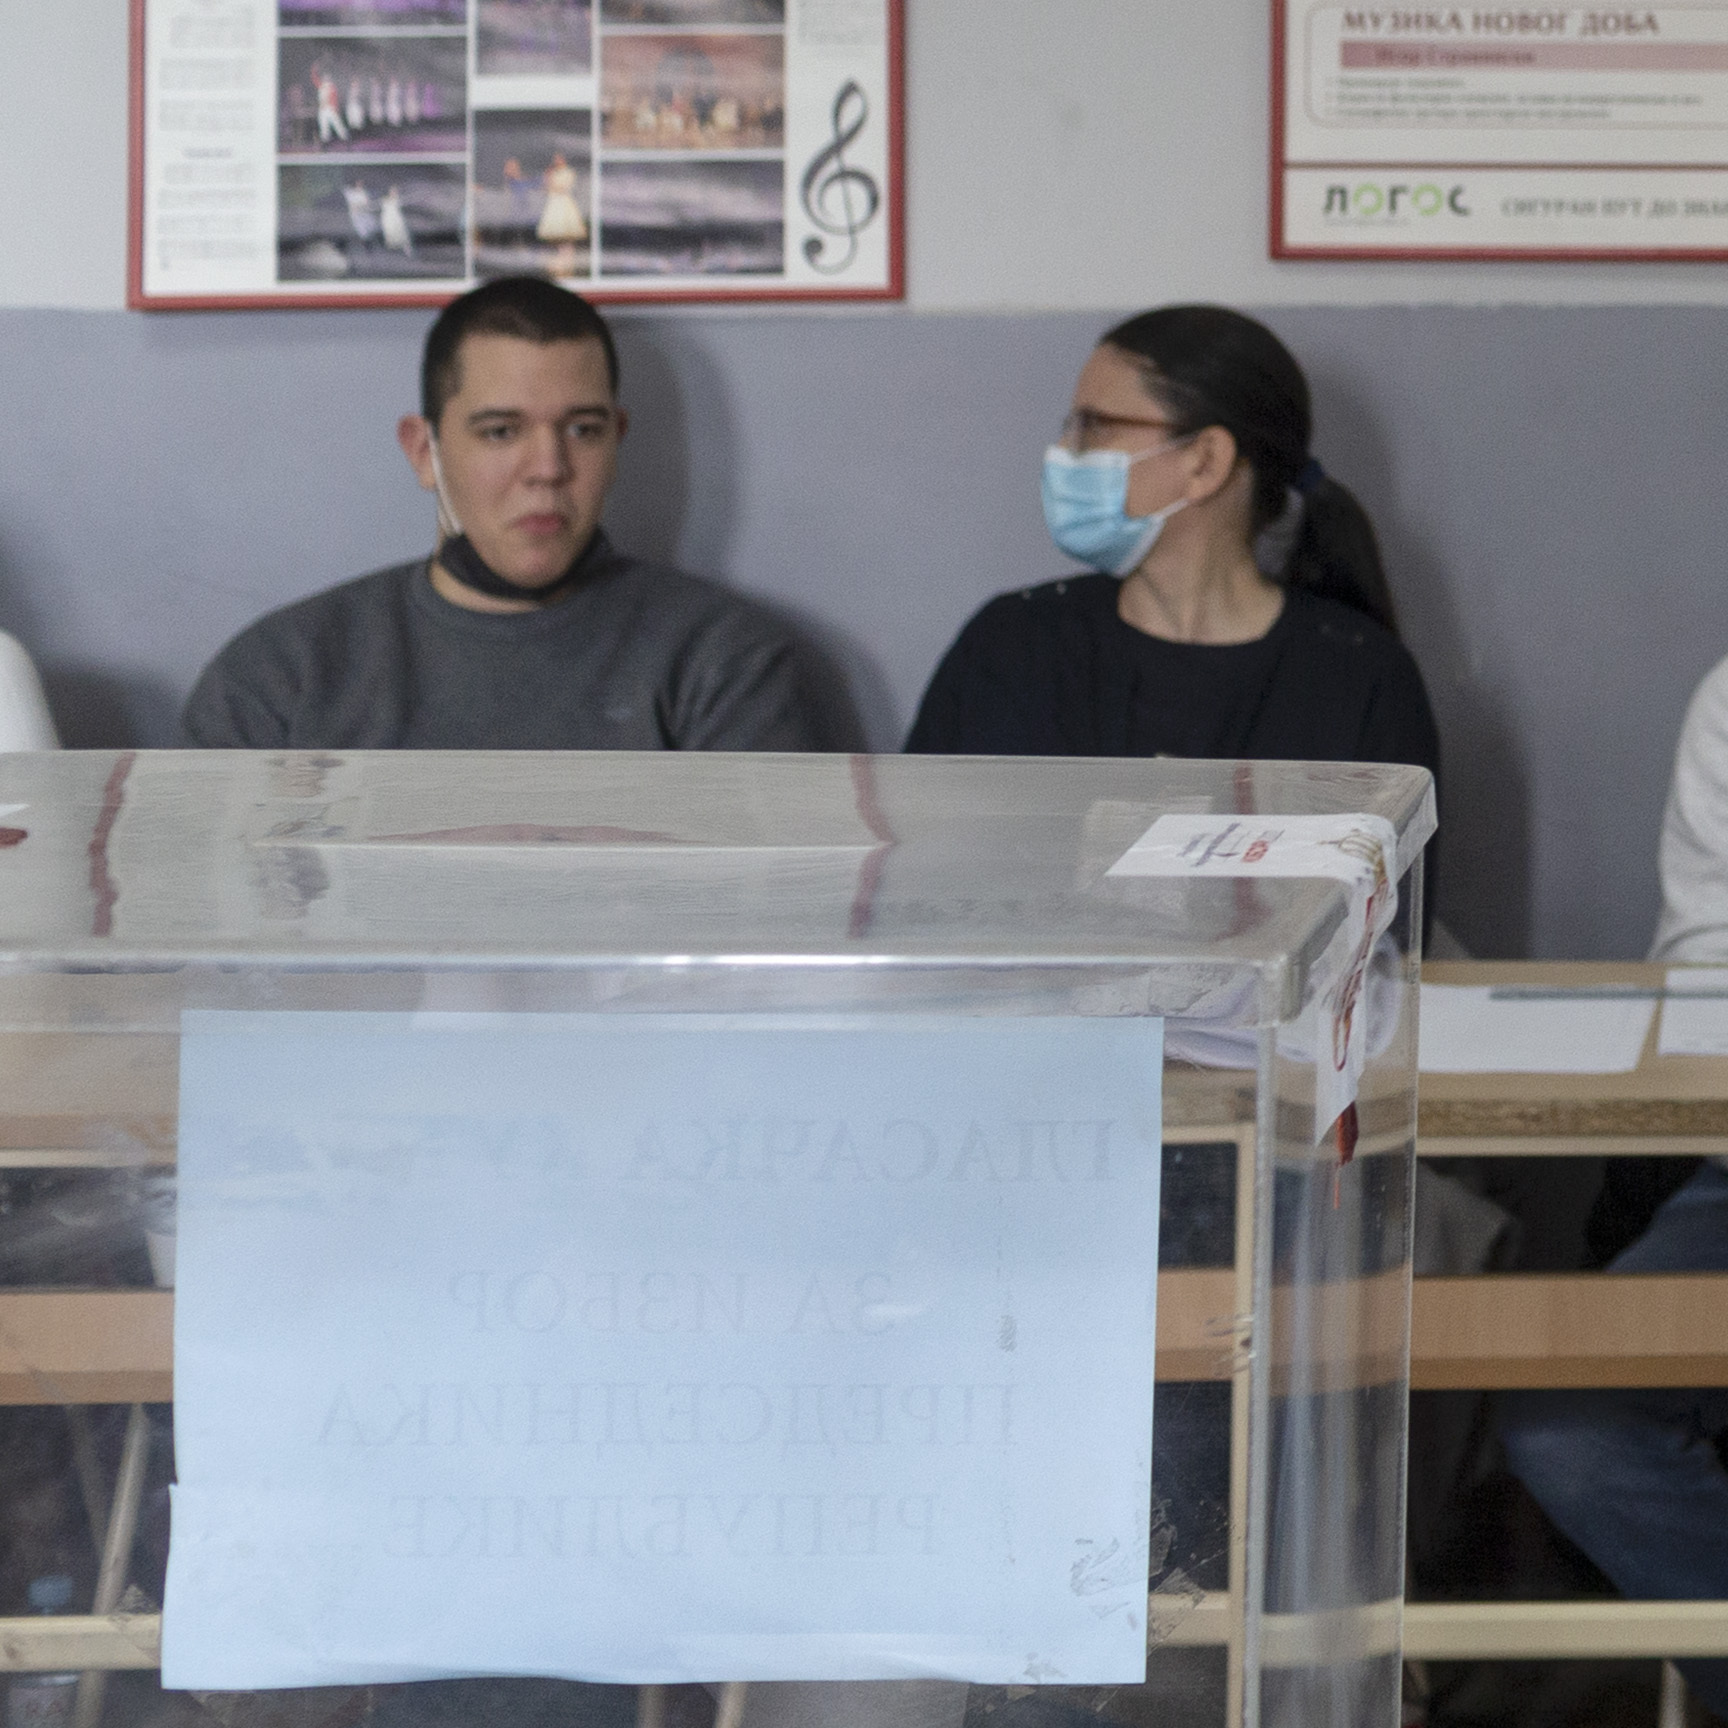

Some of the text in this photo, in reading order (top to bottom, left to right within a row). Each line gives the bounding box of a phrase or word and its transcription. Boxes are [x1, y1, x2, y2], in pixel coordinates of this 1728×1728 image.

[1343, 9, 1659, 38] МУЗИКА НОВОГ ДОБА
[1323, 183, 1471, 217] ЛОГОС
